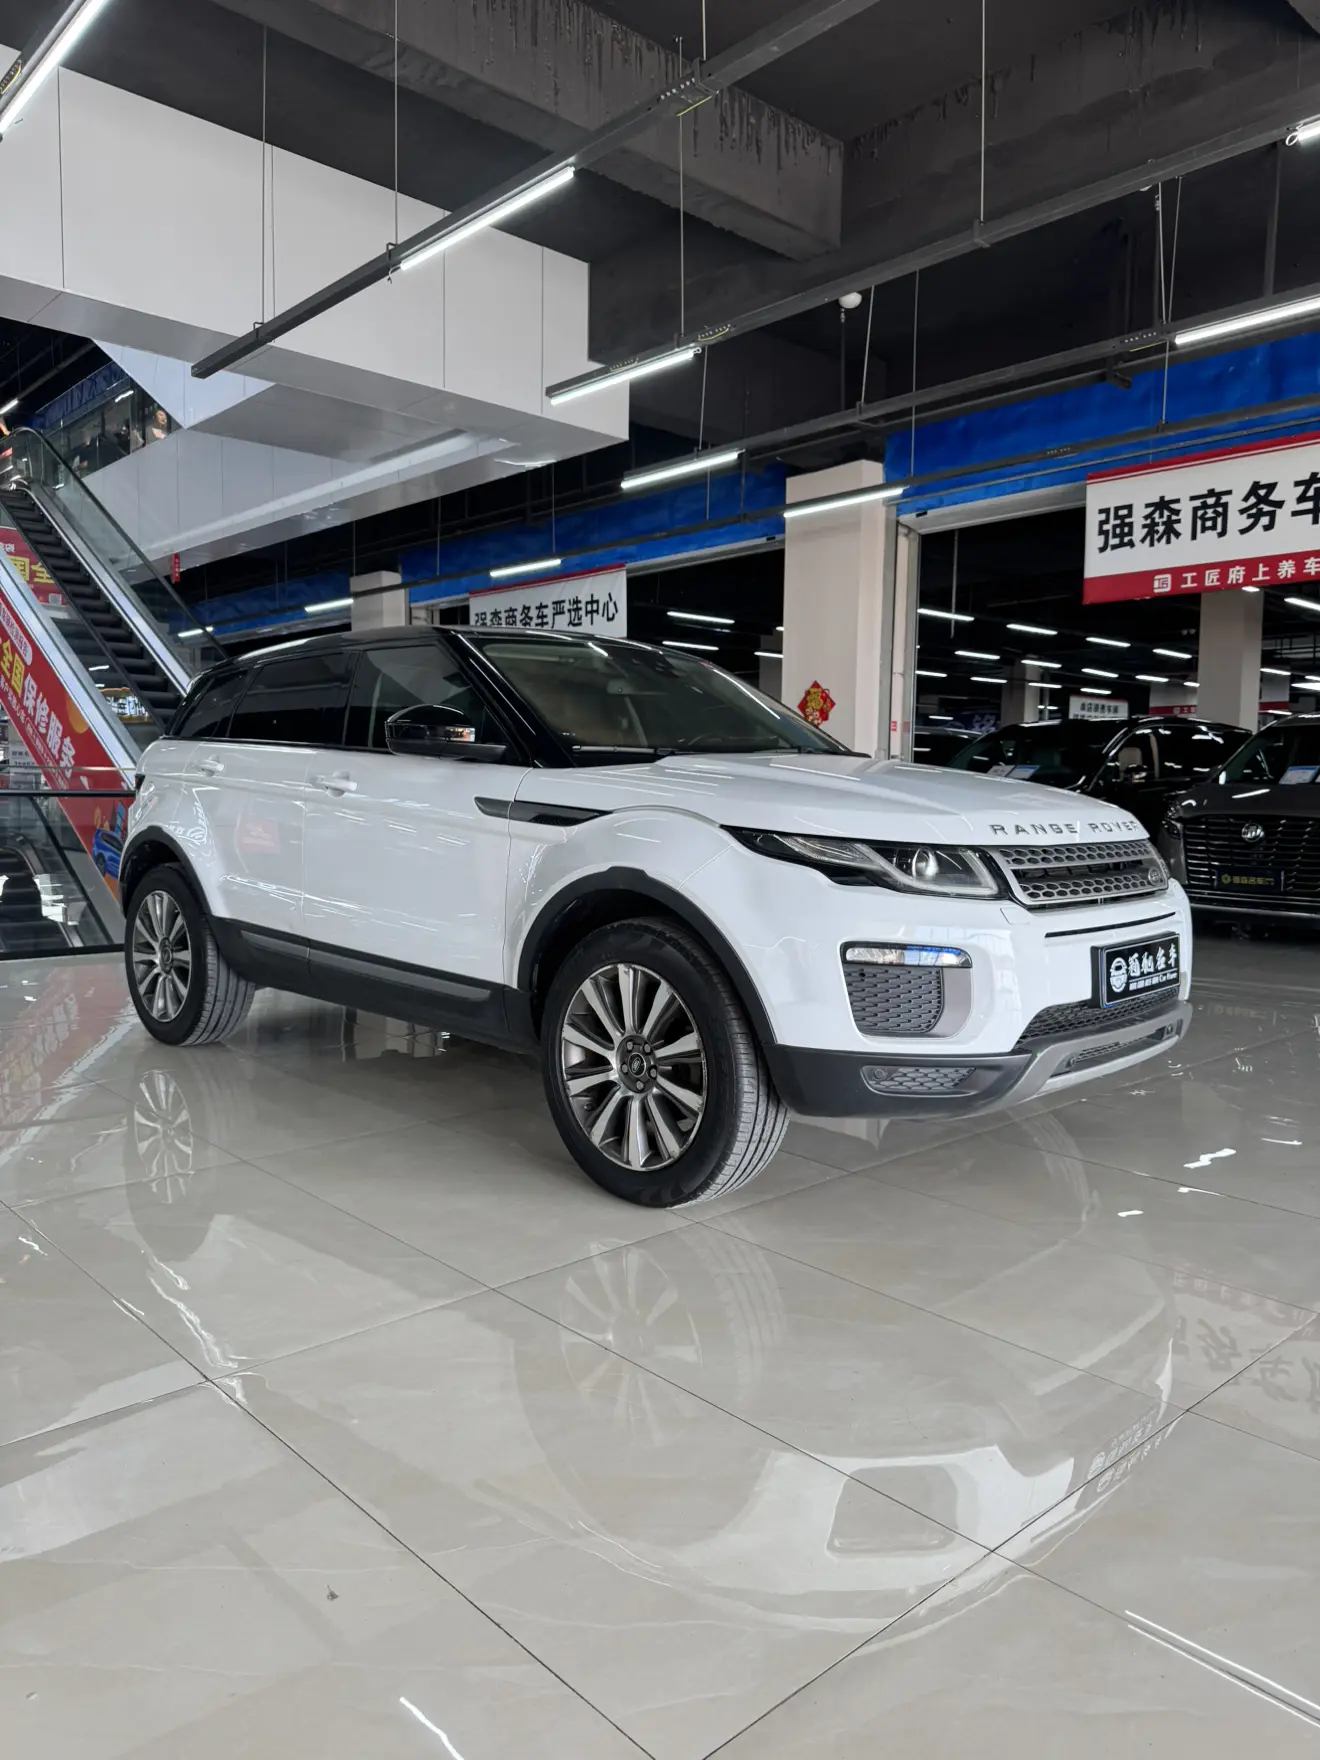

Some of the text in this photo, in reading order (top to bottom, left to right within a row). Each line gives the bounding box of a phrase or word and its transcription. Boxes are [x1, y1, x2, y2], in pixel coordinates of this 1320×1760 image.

[1097, 472, 1320, 554] 强森商务车
[1180, 557, 1320, 589] 工匠府上养车
[988, 820, 1140, 836] RANGE ROVER
